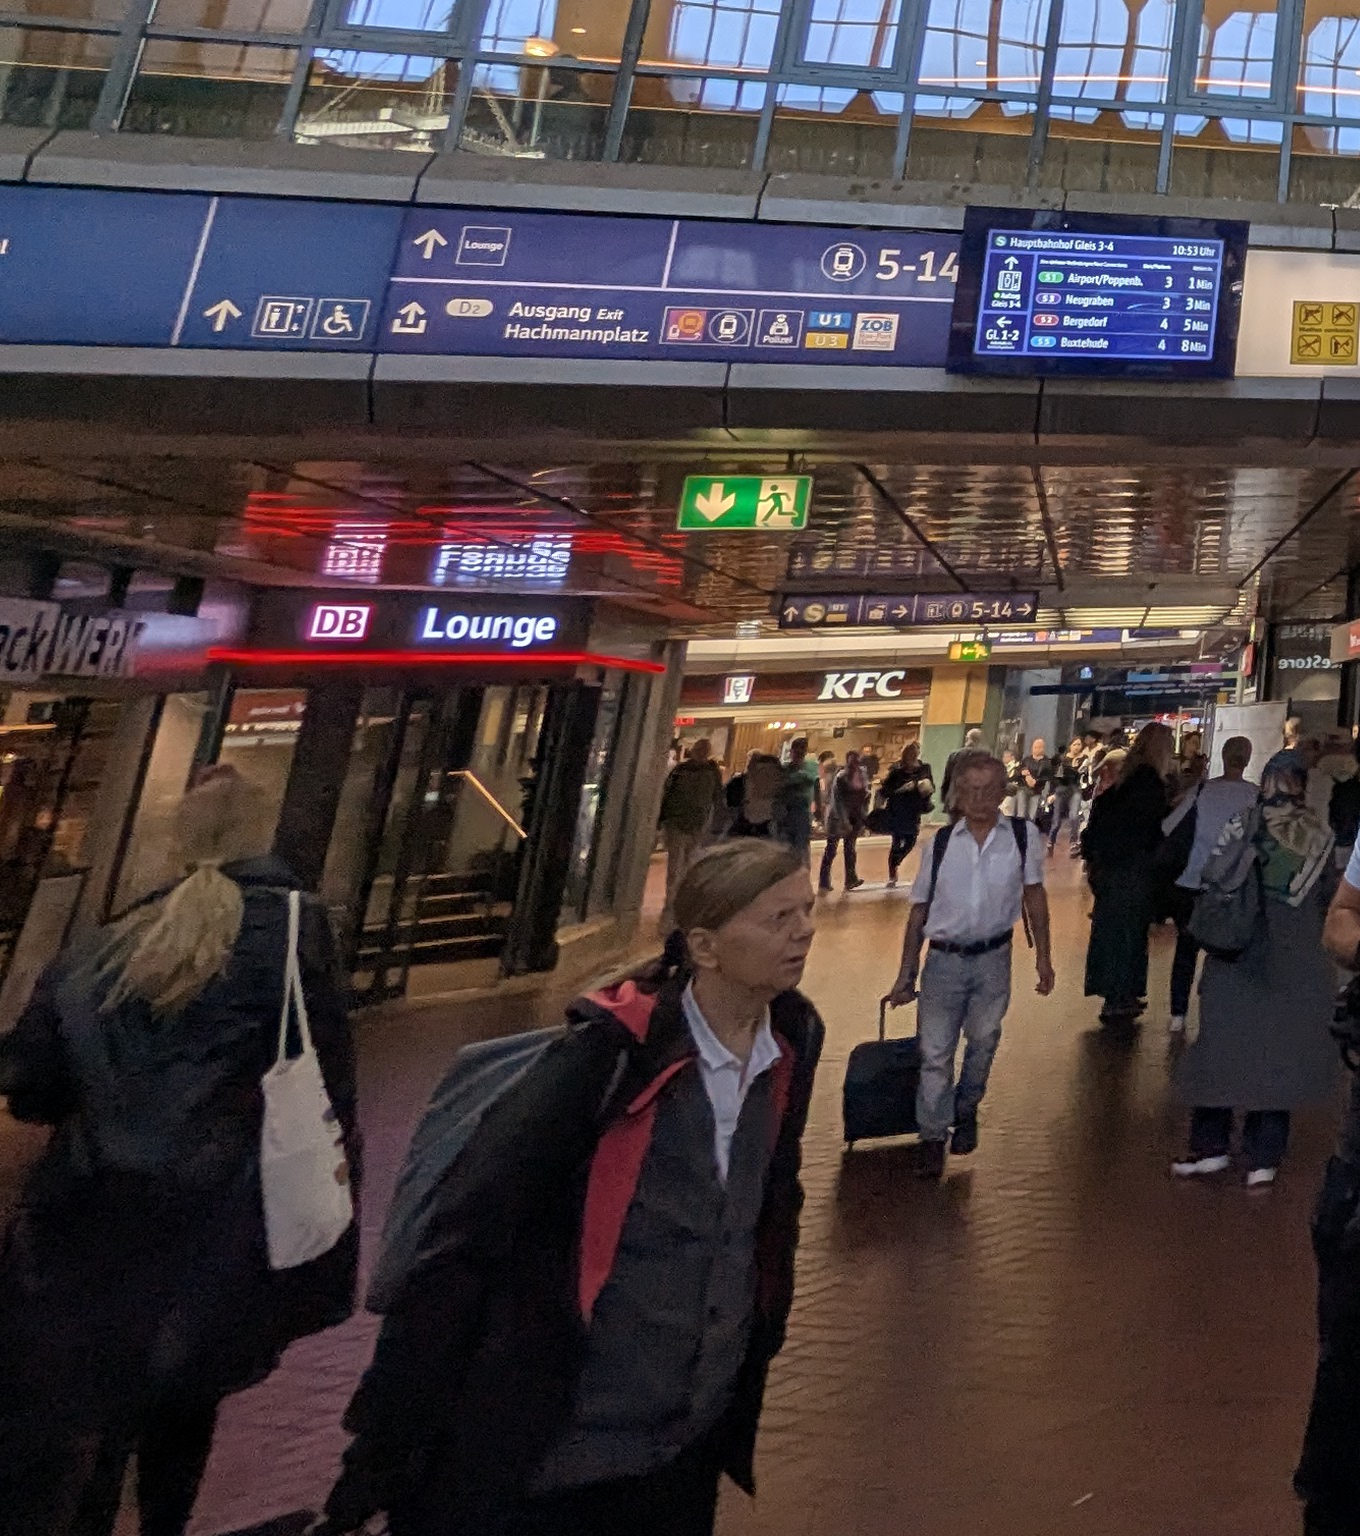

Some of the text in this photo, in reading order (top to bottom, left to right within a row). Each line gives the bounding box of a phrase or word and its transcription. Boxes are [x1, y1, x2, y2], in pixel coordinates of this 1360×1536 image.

[464, 239, 504, 252] Lounge
[1009, 237, 1075, 249] Hauptbahnhof
[1075, 241, 1097, 251] Gleis
[1098, 242, 1114, 251] 3-4
[1172, 245, 1216, 257] 10:53 Uhr
[875, 248, 960, 284] 5-14
[1164, 276, 1173, 289] 3
[1188, 277, 1195, 290] 1
[1196, 278, 1213, 290] Min
[1065, 294, 1211, 311] Neugraben 3 3 Min
[508, 301, 624, 323] Ausgang Exit
[860, 320, 893, 332] ZOB
[1063, 315, 1209, 331] Bergedorf 4 5 Min
[503, 323, 649, 344] Hachmannplatz
[985, 329, 1020, 341] GL 1-2
[1060, 337, 1207, 352] Buxtehude 4 8 Min
[970, 601, 1013, 618] 5-14
[315, 608, 365, 634] DB
[421, 607, 557, 646] Lounge
[816, 670, 906, 701] KFC
